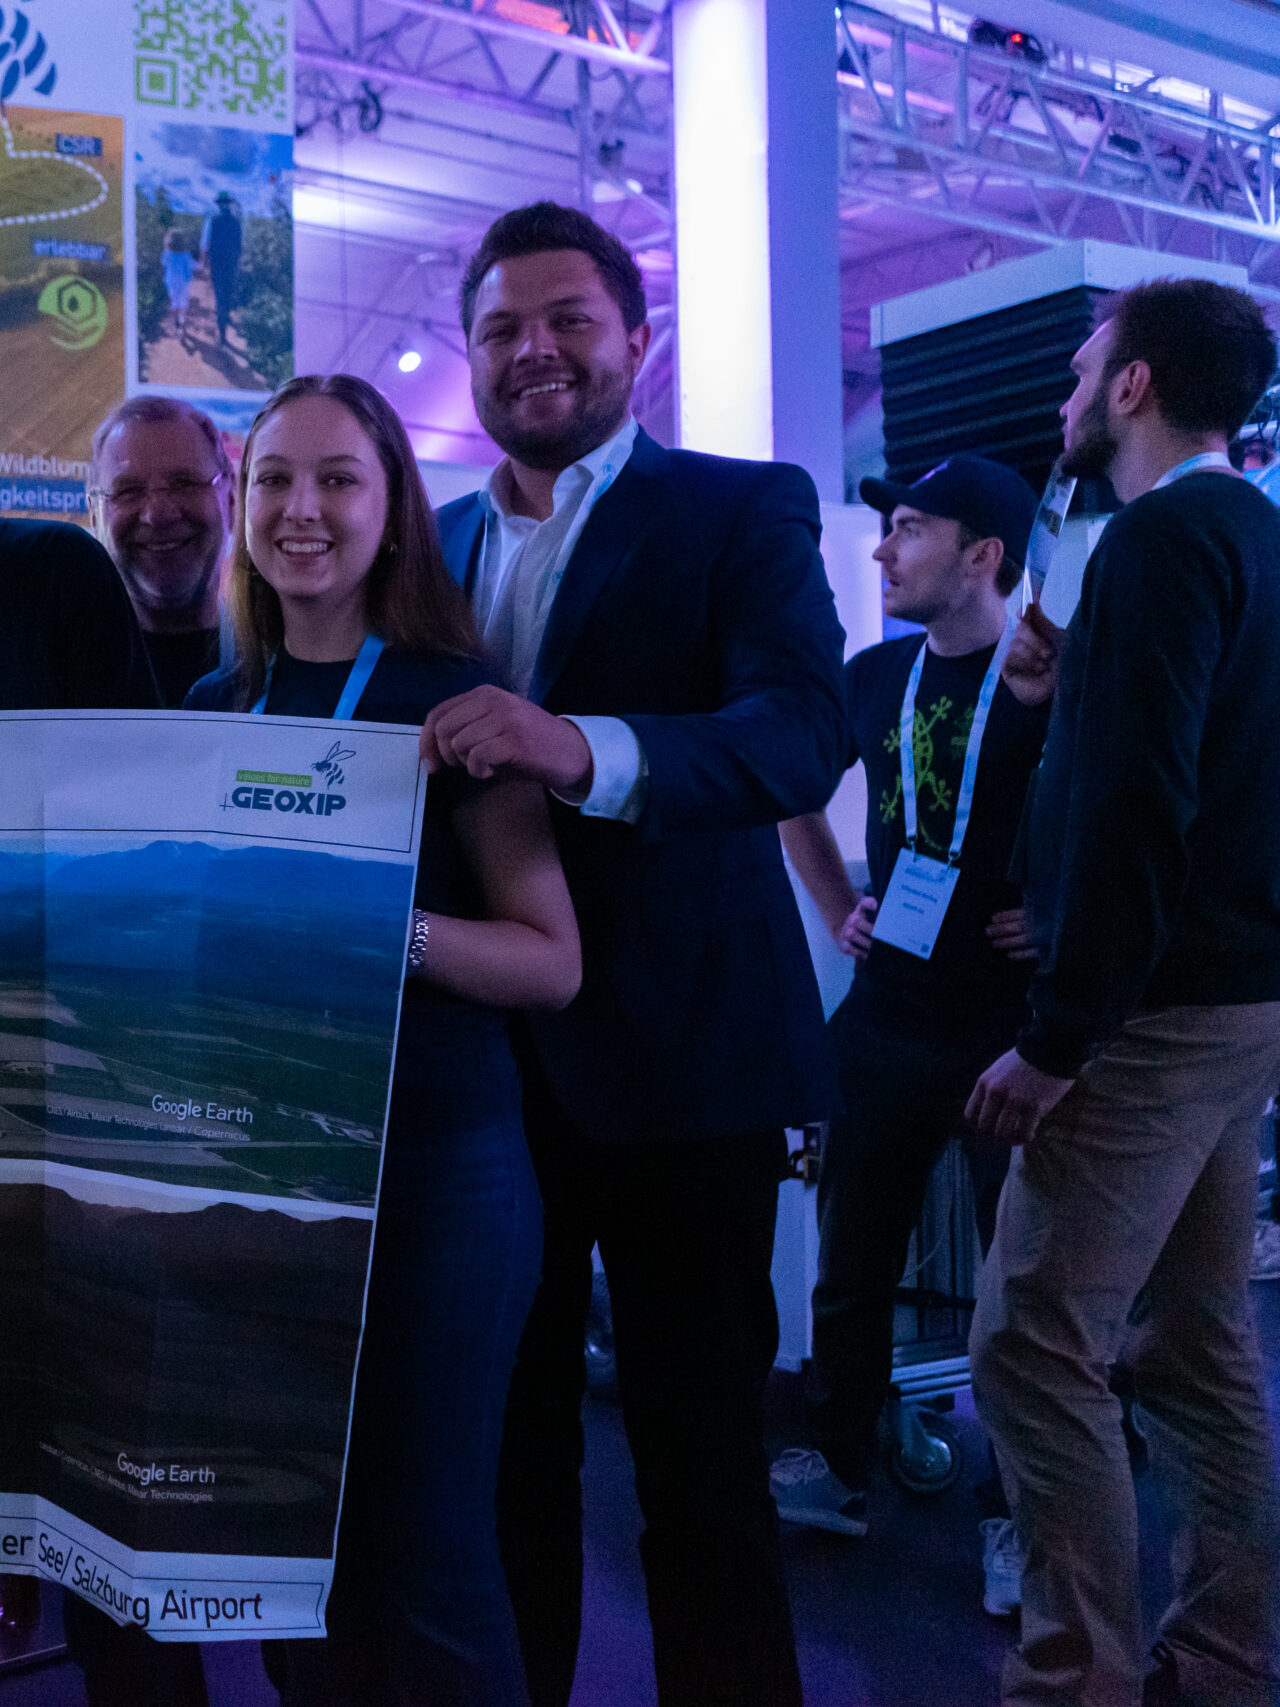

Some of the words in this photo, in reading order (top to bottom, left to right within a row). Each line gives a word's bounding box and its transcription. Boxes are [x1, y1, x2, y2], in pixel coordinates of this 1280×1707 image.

[59, 136, 97, 156] CSR
[231, 786, 347, 816] GEOXIP
[151, 1094, 202, 1121] Google
[206, 1102, 253, 1124] Earth
[117, 1452, 166, 1487] Google
[169, 1464, 217, 1484] Earth
[161, 1588, 263, 1629] Airport
